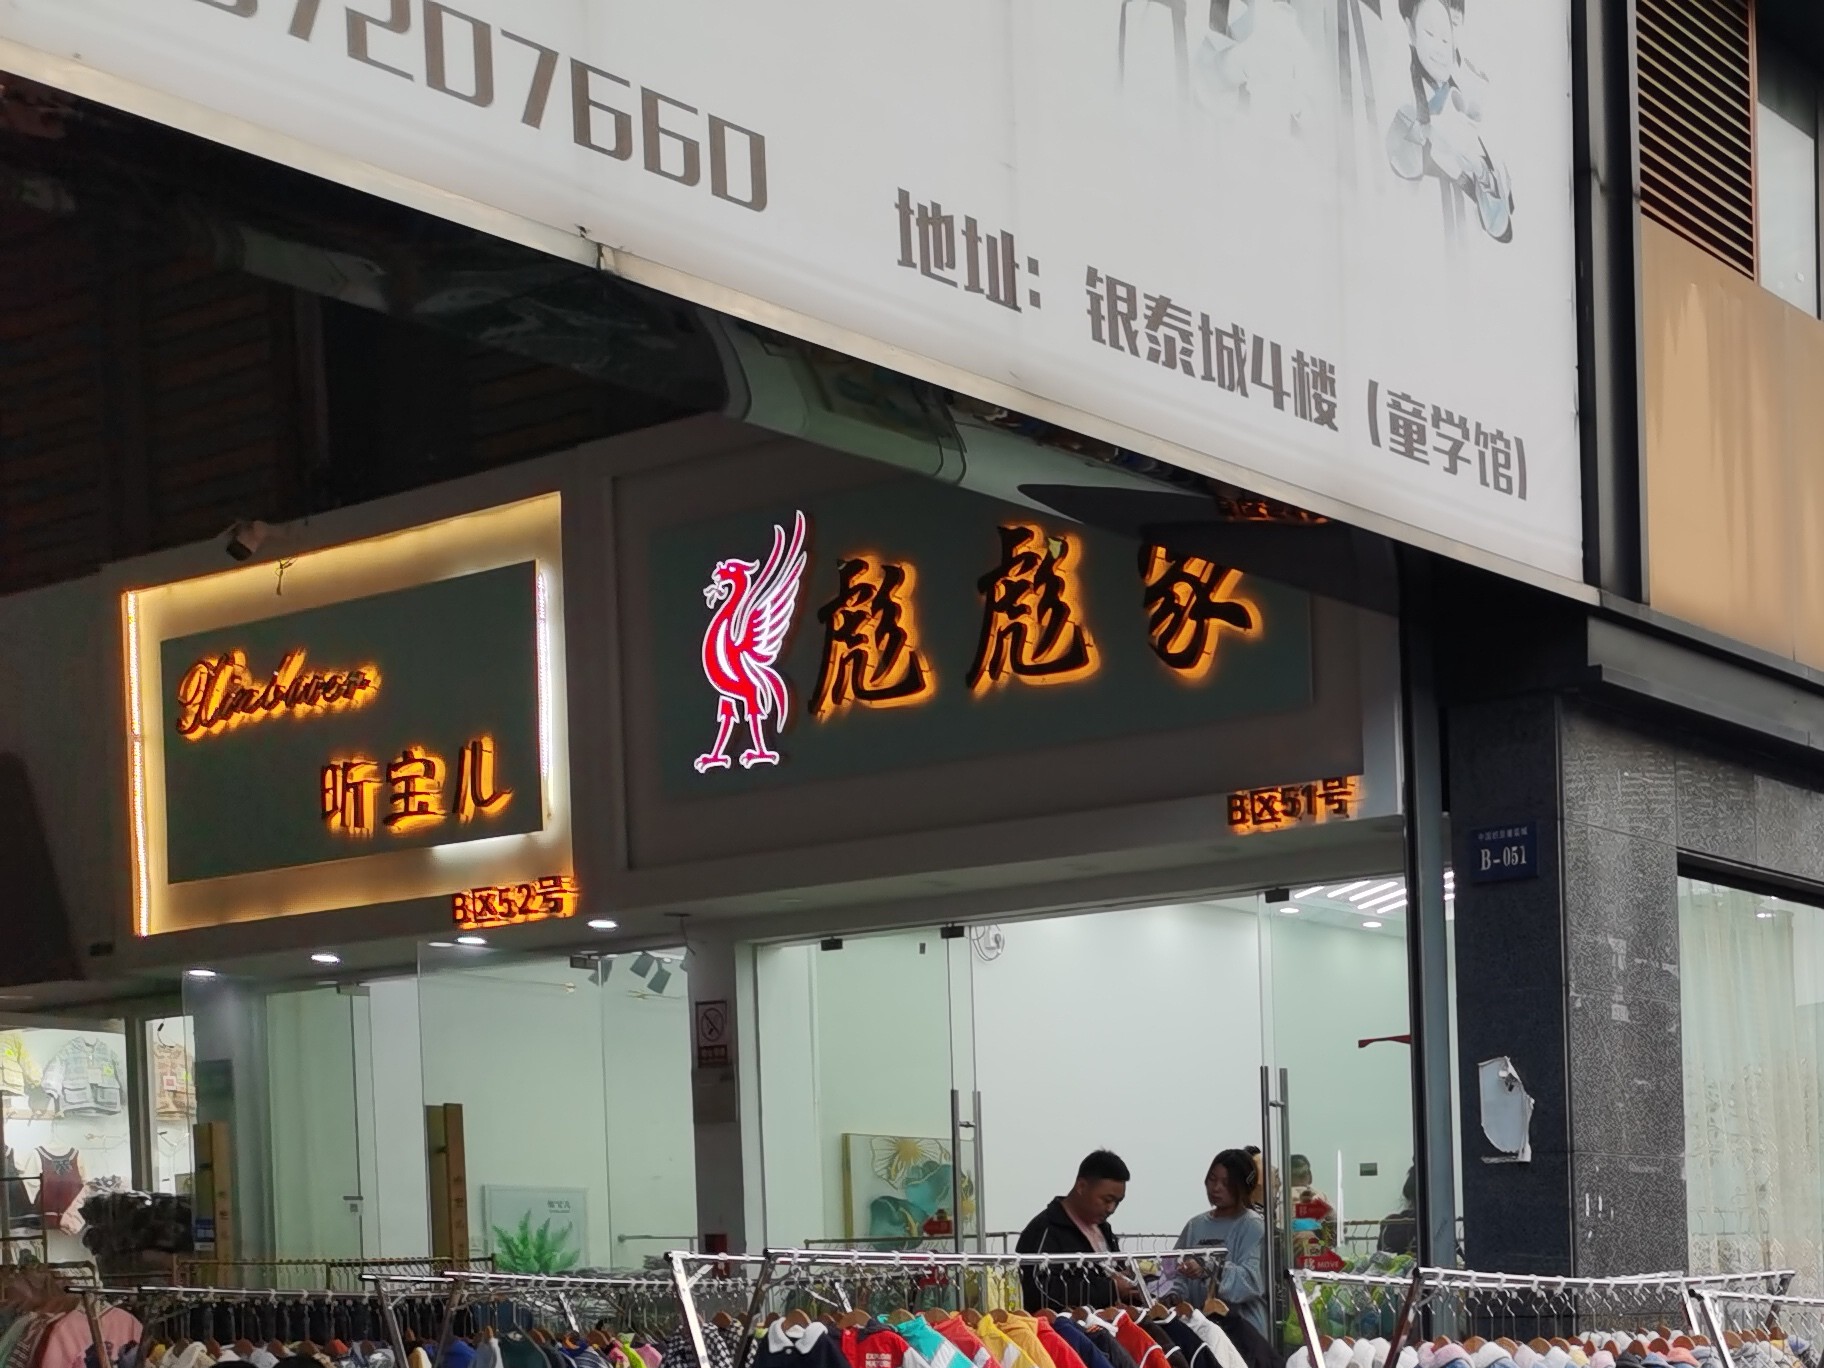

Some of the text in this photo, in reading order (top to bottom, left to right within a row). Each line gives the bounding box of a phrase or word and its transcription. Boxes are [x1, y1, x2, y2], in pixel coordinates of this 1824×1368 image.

[320, 737, 513, 834] 昕宝儿
[1226, 776, 1354, 830] B区51号
[1480, 845, 1527, 871] B-051
[452, 875, 572, 927] B区52号
